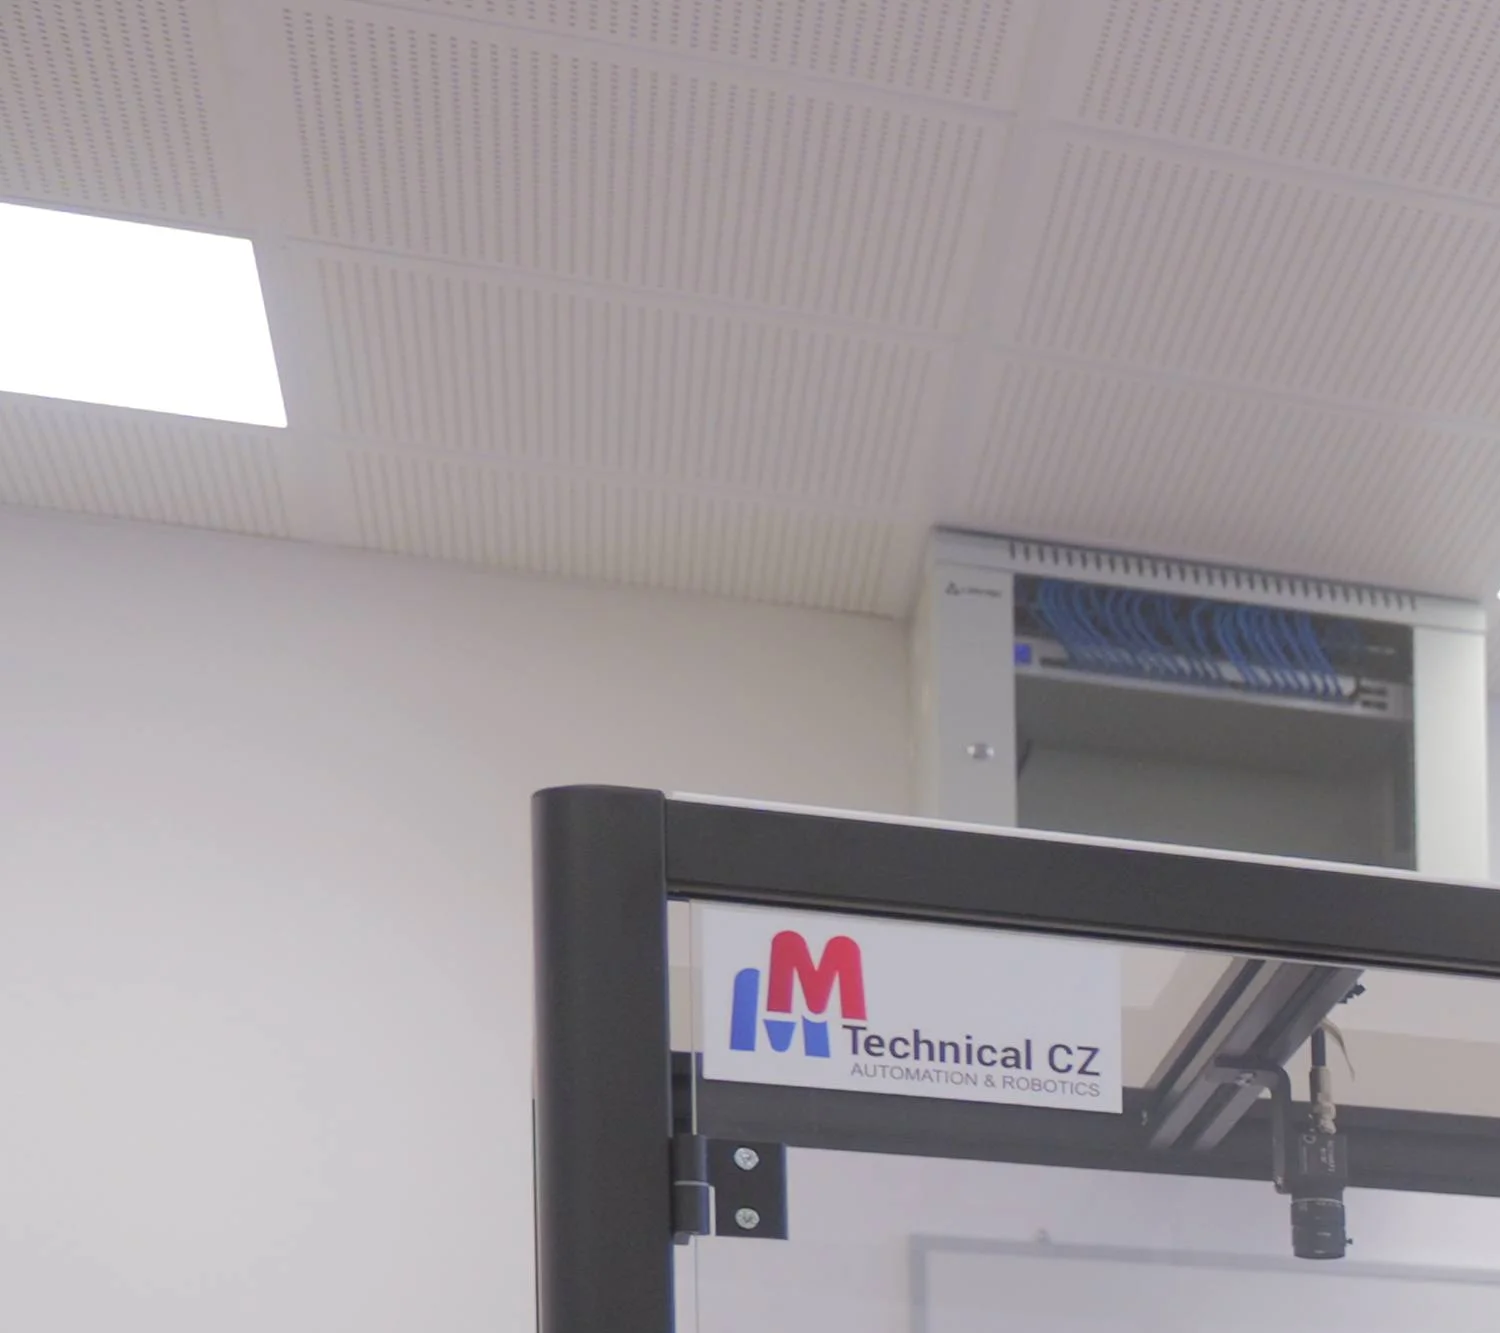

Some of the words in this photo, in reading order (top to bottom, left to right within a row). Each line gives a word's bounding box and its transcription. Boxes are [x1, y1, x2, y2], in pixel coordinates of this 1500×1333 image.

[842, 1024, 1033, 1071] Technical
[1048, 1043, 1101, 1077] CZ
[850, 1062, 978, 1087] AUTOMATION
[983, 1074, 996, 1089] &
[1002, 1075, 1101, 1098] ROBOTICS
